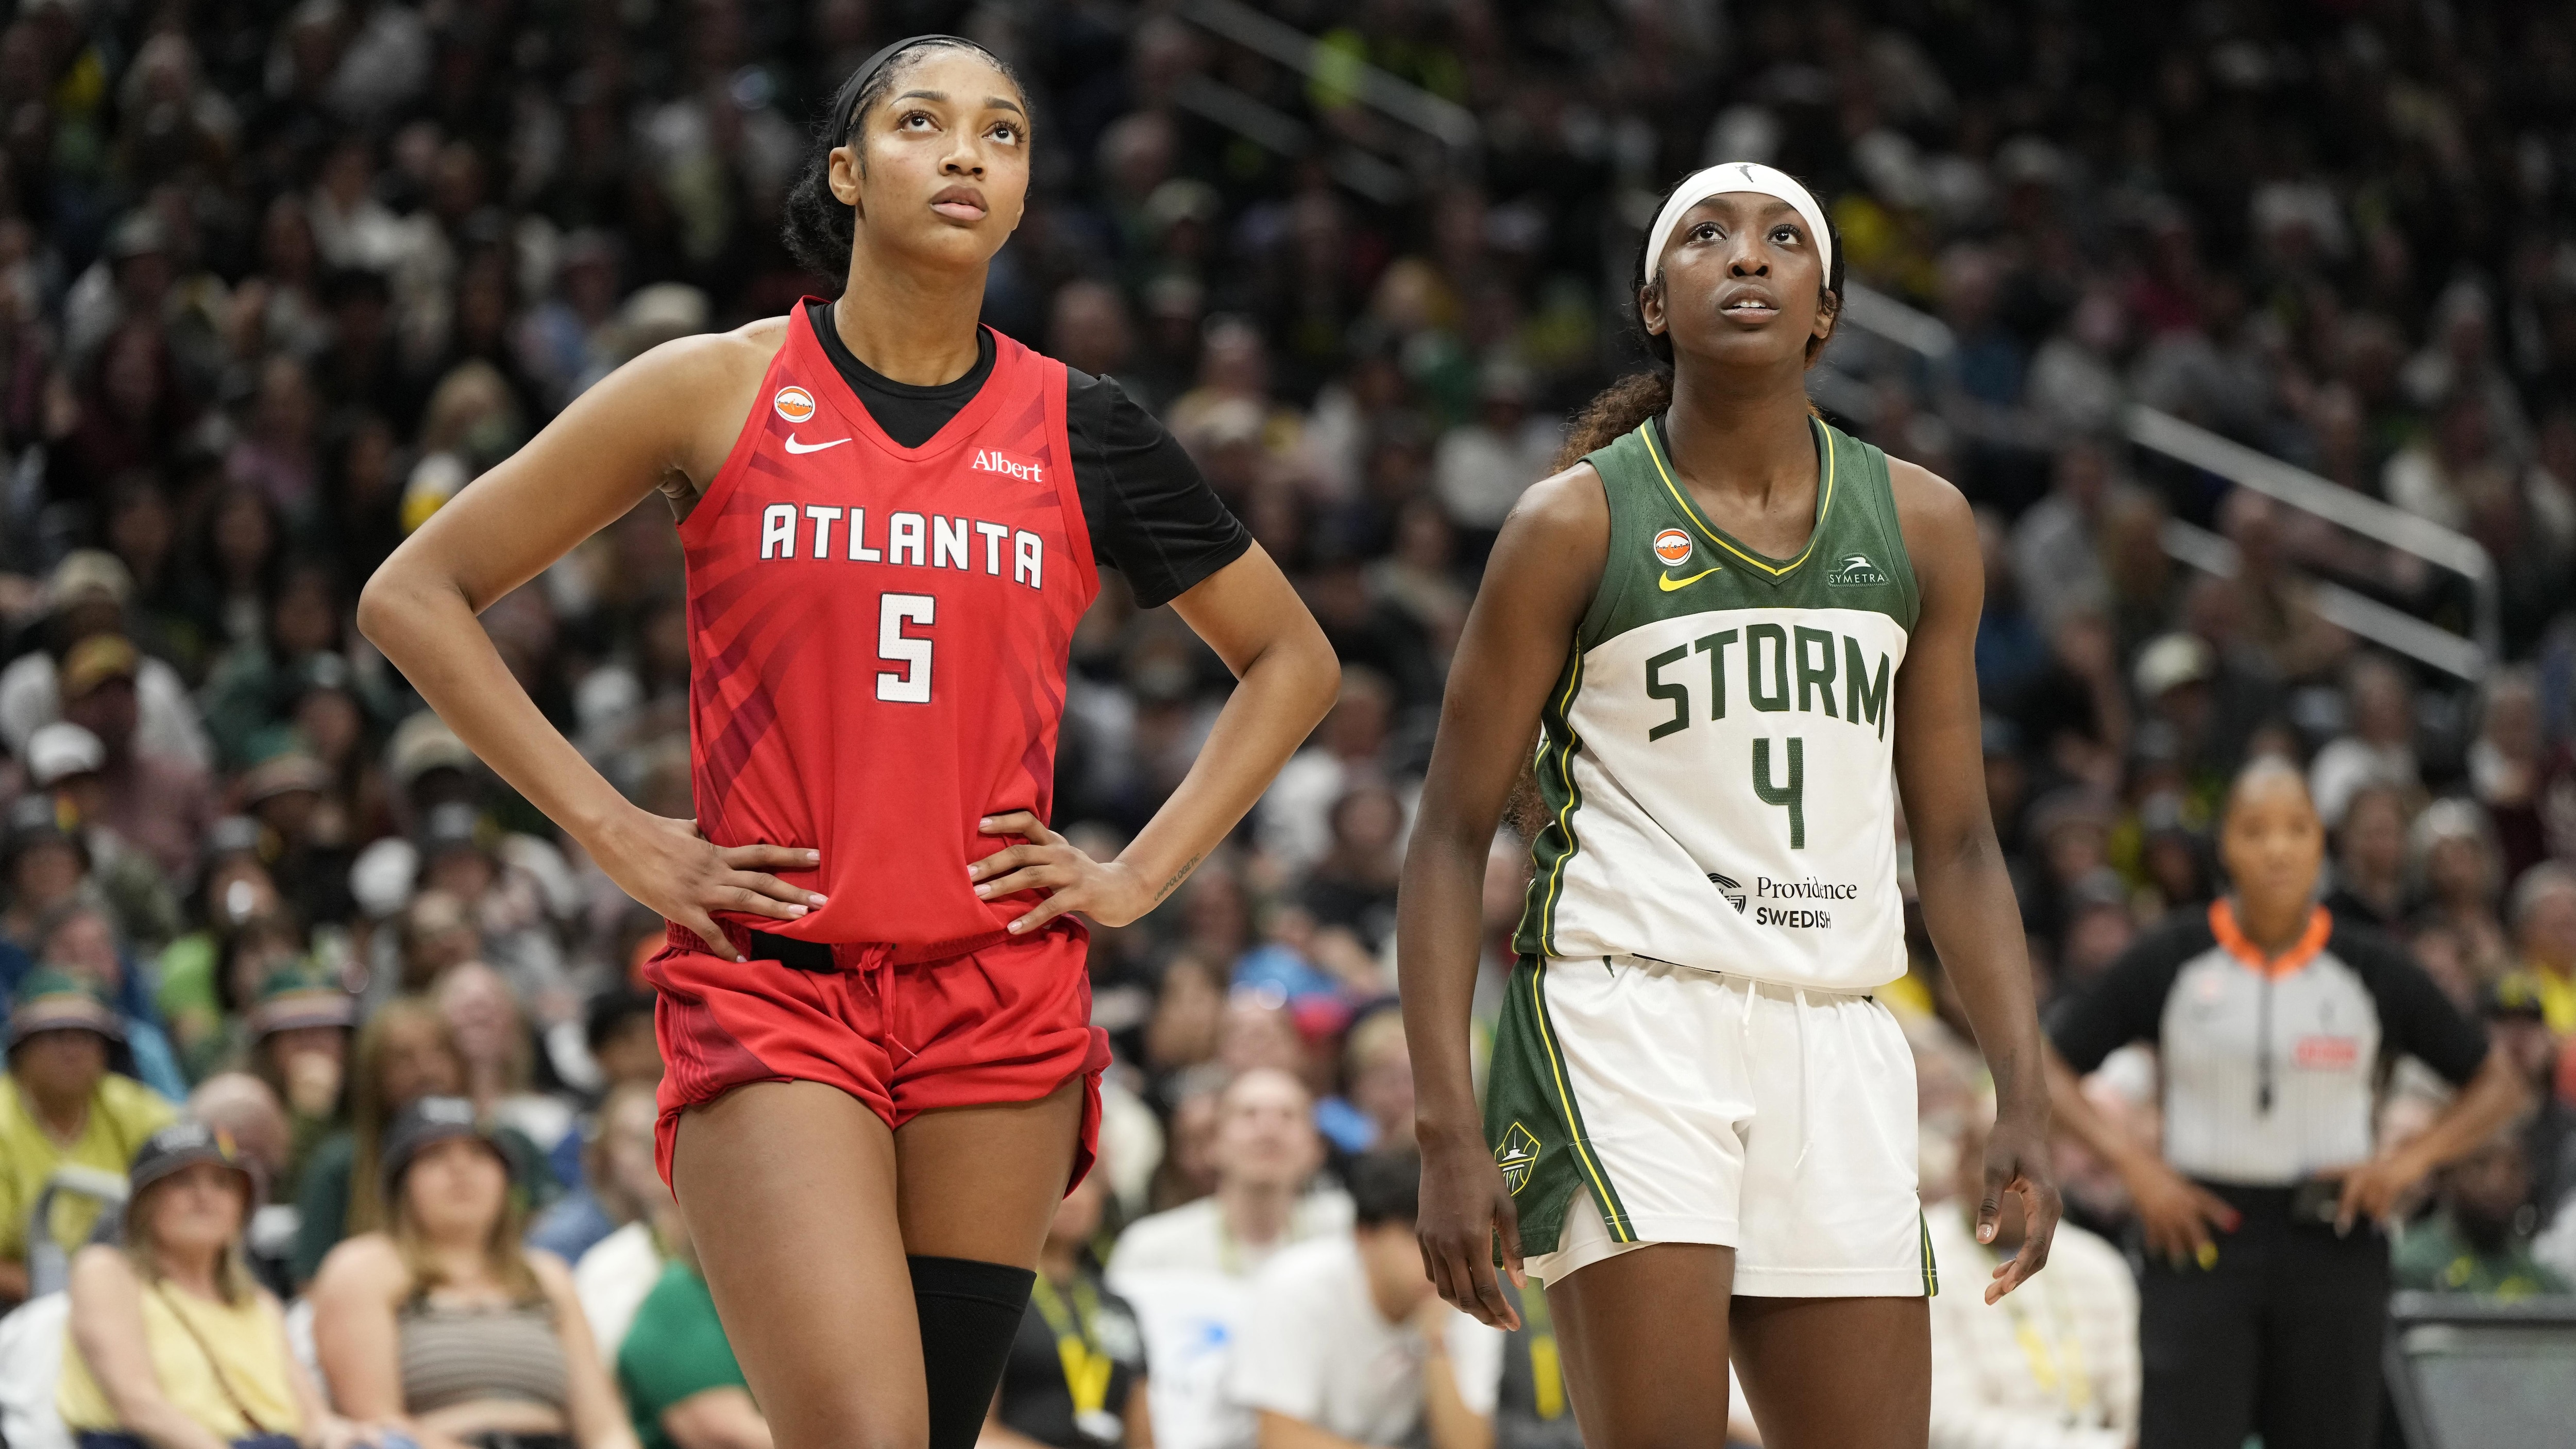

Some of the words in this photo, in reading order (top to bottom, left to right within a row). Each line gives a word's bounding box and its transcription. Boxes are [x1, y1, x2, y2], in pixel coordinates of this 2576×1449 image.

[972, 449, 1043, 482] Albert
[760, 502, 1043, 590] ATLANTA
[1829, 574, 1885, 583] SYMETRA
[876, 593, 935, 703] 5
[1646, 623, 1889, 743] STORM
[1753, 737, 1805, 849] 4
[1154, 853, 1201, 901] UNAPOLOGETIC
[1756, 876, 1857, 899] Providence
[1756, 907, 1831, 929] SWEDISH
